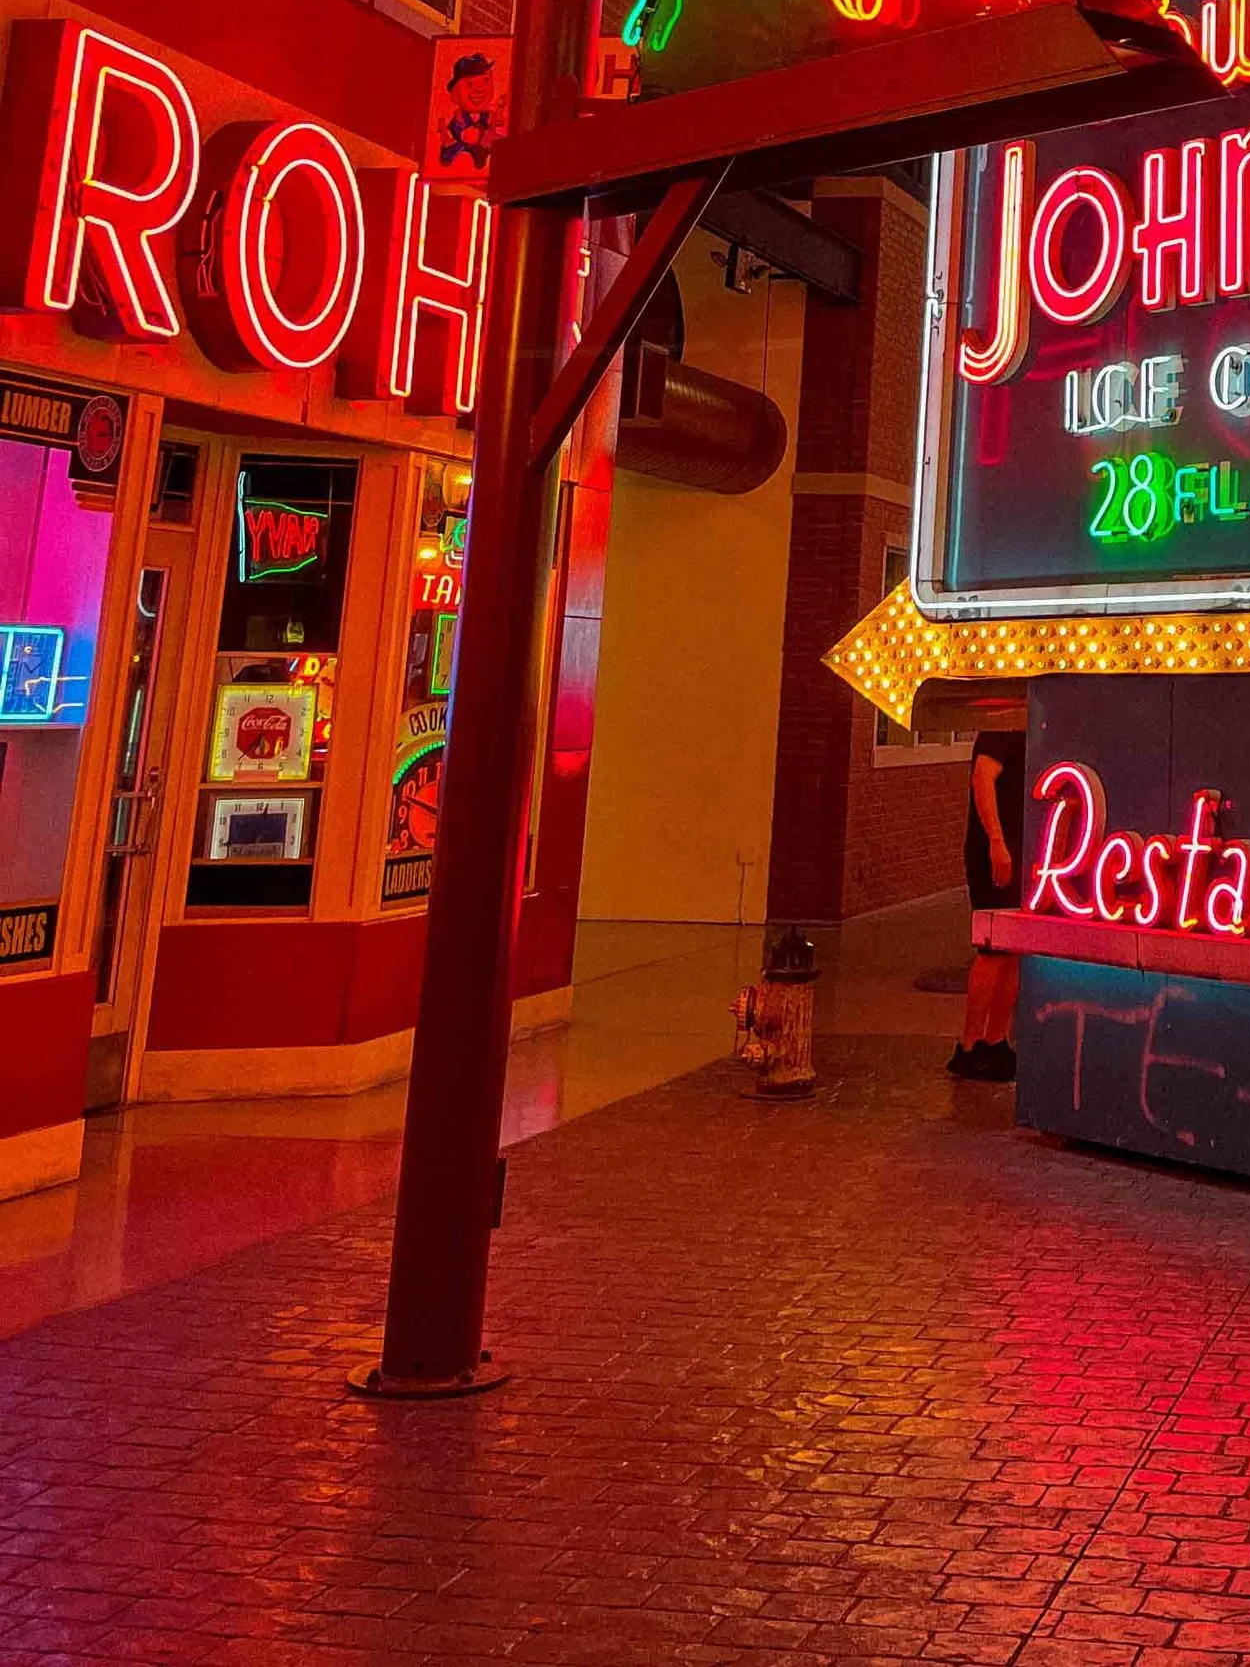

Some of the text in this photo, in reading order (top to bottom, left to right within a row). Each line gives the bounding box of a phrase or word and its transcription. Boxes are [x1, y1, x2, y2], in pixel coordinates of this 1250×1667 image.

[26, 20, 496, 416] ROH
[1, 390, 73, 434] LUMBER
[1063, 350, 1184, 436] ICE
[1089, 449, 1176, 542] 28
[399, 805, 408, 824] 9
[400, 830, 408, 849] 8
[385, 859, 432, 896] LADDERS
[0, 911, 47, 957] SHES
